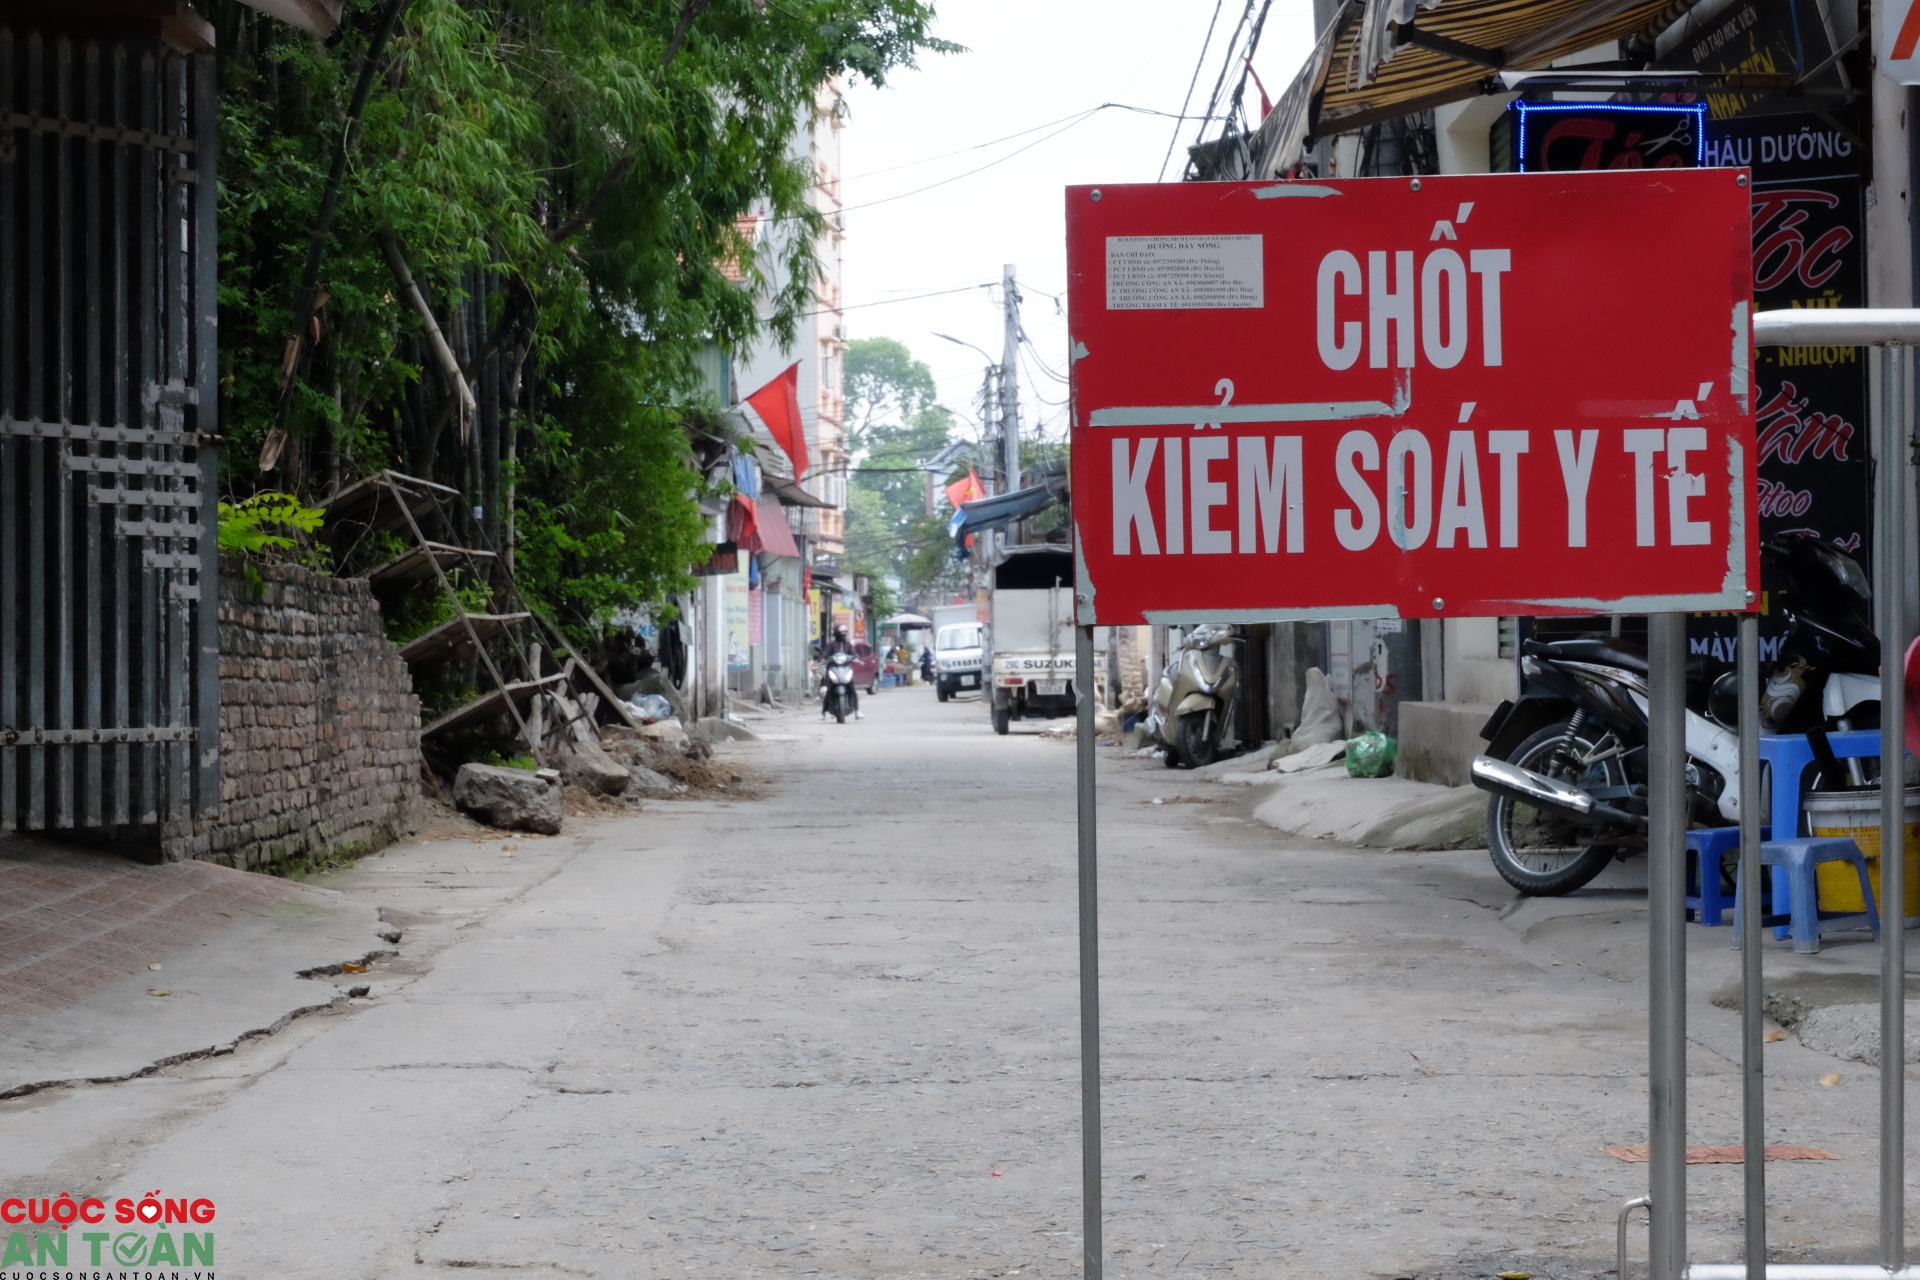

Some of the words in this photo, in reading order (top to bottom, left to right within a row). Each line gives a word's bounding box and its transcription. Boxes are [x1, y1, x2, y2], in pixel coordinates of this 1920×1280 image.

[1707, 30, 1724, 54] TẠO
[1723, 17, 1740, 42] HỌC
[1761, 126, 1852, 163] DƯỠNG
[1316, 202, 1511, 370] CHỐT
[1112, 378, 1304, 554] KIỂM
[1333, 402, 1529, 552] SOÁT
[1555, 429, 1599, 548] Y
[1623, 382, 1712, 547] TẾ
[1023, 659, 1076, 669] SUZUK
[1689, 631, 1737, 663] MÀY
